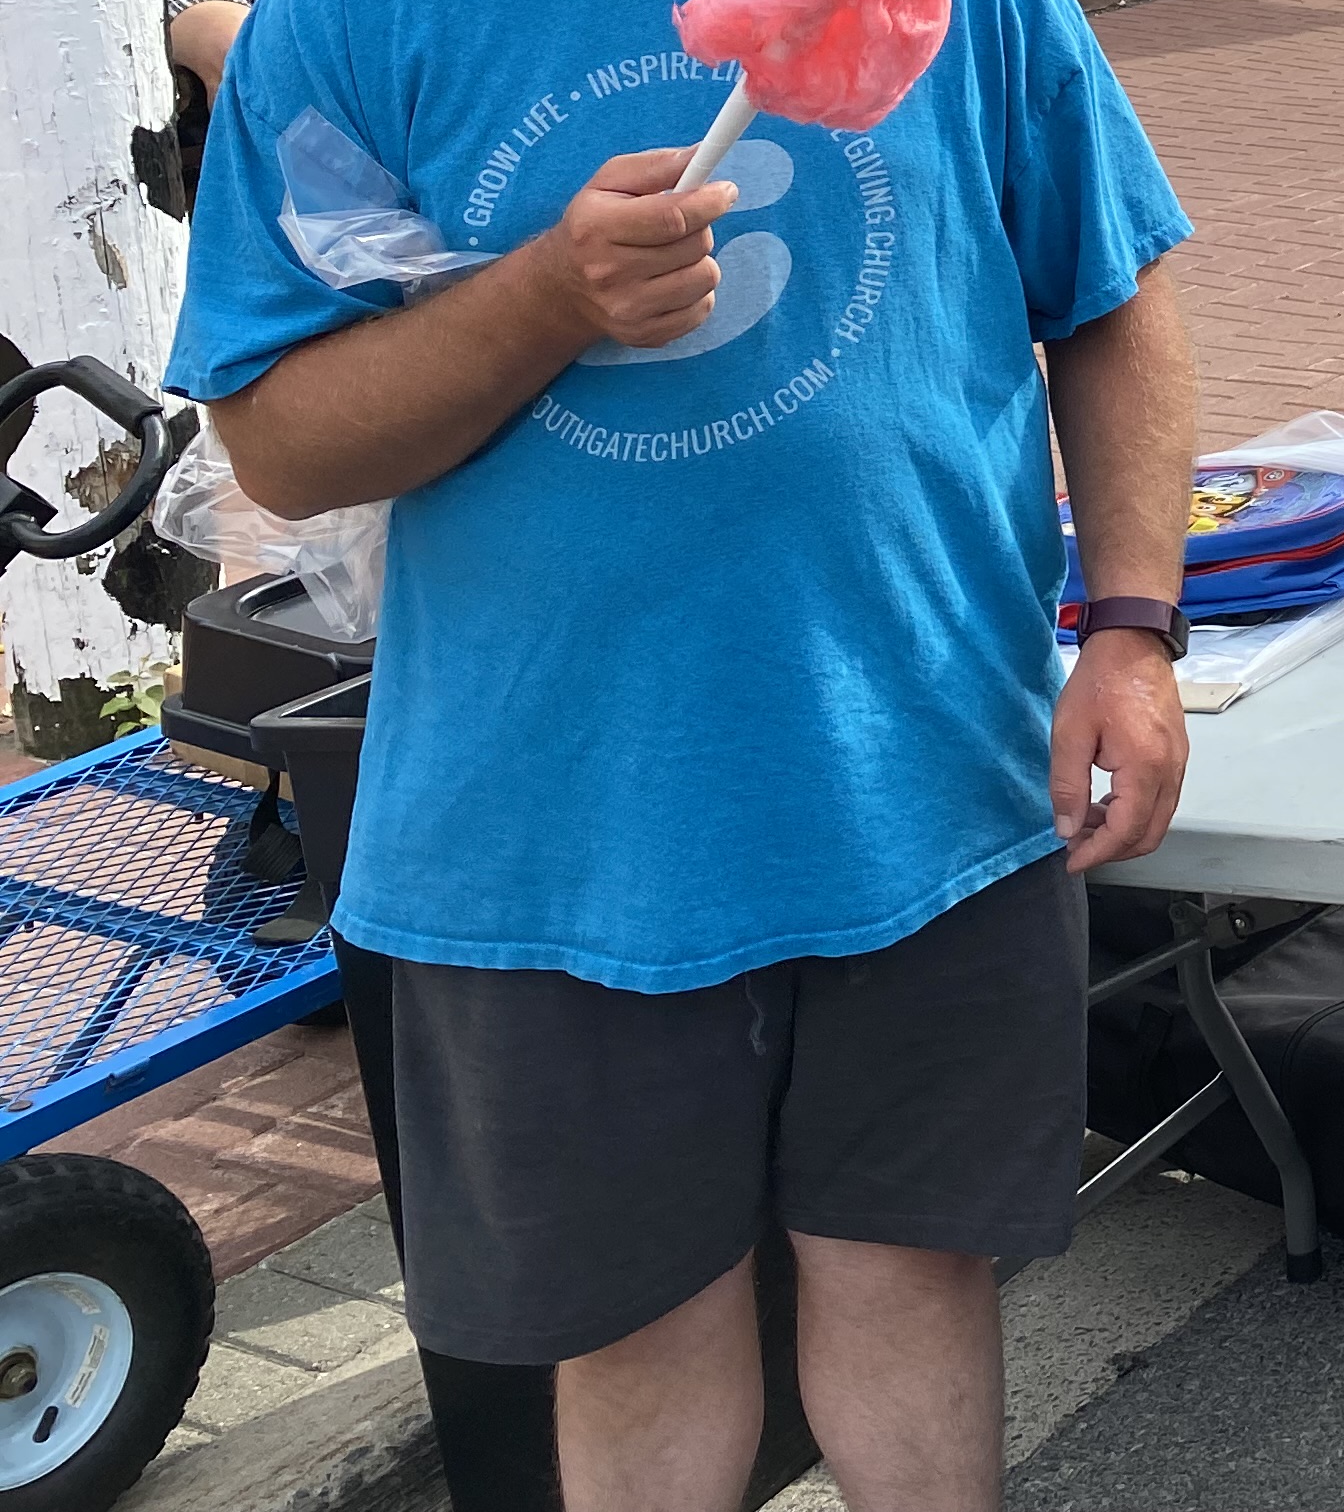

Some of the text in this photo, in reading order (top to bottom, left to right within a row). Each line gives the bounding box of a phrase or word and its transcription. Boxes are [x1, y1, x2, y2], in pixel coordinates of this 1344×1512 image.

[585, 51, 704, 99] INSPIRE
[462, 93, 571, 228] GROW LIFE
[837, 136, 895, 345] GIVING CHURCH
[531, 356, 835, 463] OUTHGATECHURCH.COM
